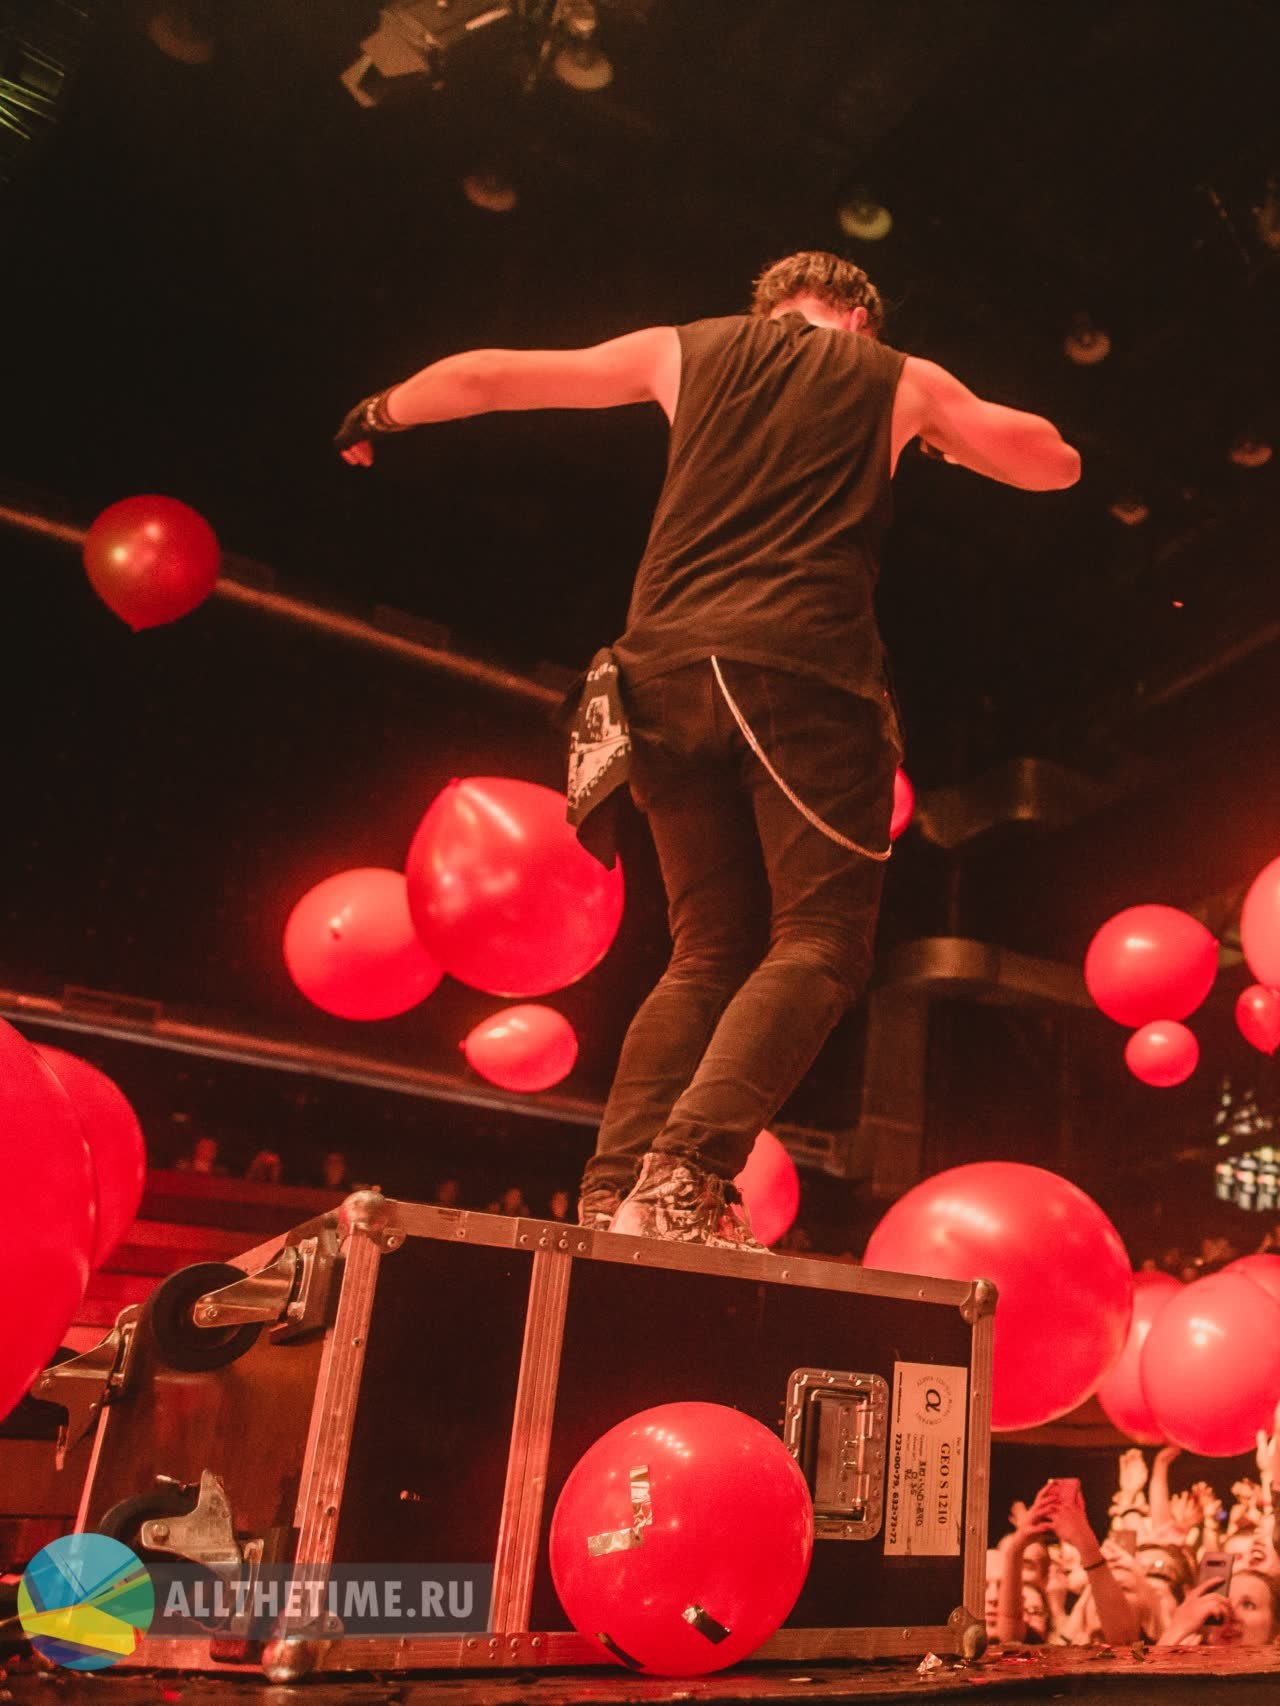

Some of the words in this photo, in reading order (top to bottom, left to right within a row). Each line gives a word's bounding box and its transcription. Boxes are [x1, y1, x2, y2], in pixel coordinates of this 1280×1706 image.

[941, 1443, 951, 1477] GEO
[940, 1481, 949, 1489] S
[938, 1494, 948, 1525] 1210
